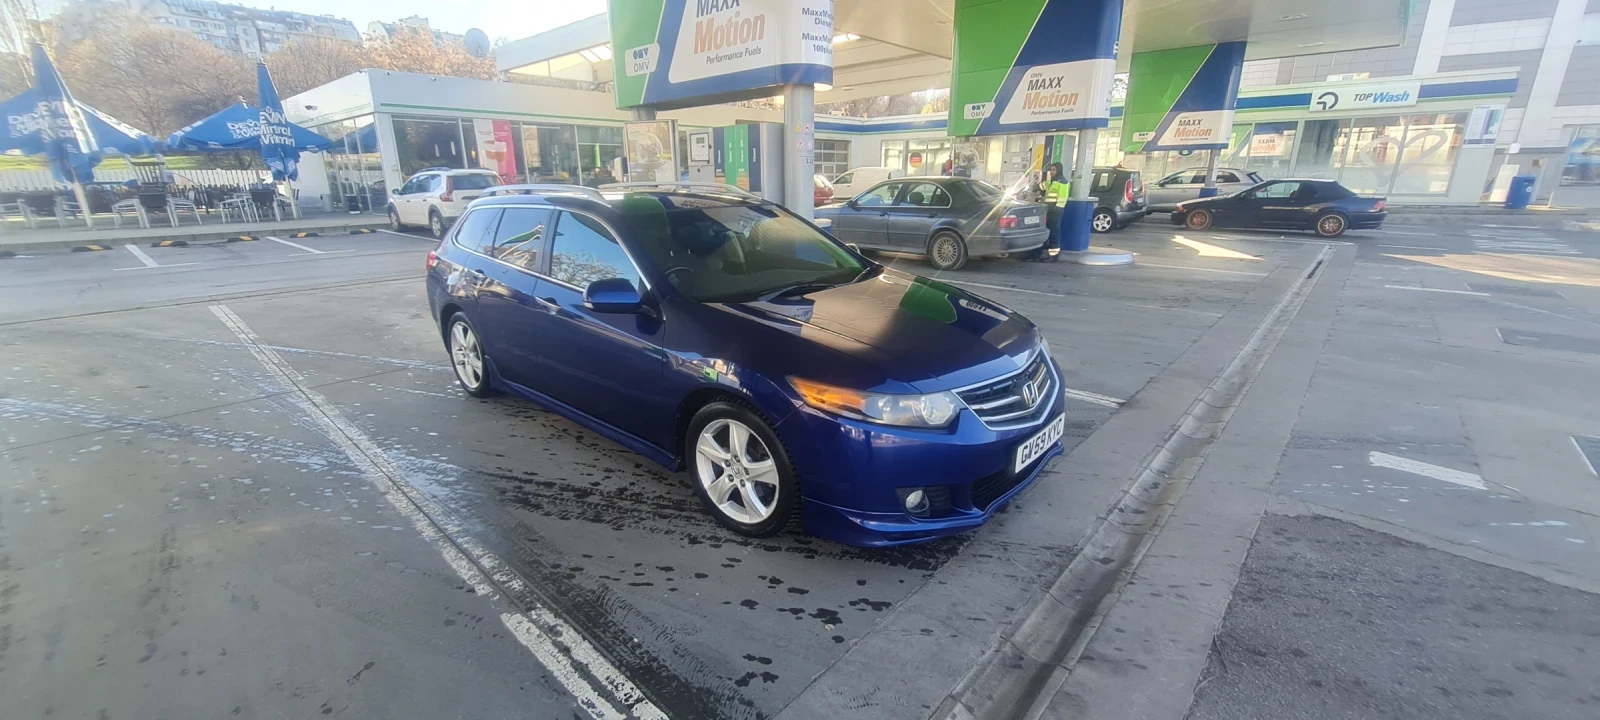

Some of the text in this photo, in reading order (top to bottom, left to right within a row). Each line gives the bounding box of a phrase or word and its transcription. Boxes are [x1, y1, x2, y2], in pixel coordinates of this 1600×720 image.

[694, 12, 765, 54] Motion
[706, 46, 762, 64] Performance Fuels
[633, 61, 650, 72] OMV
[1027, 76, 1065, 91] MAXX
[1022, 91, 1079, 110] Motion
[1177, 119, 1203, 127] MAXX
[1173, 127, 1212, 137] Motion
[1047, 418, 1062, 445] KYC
